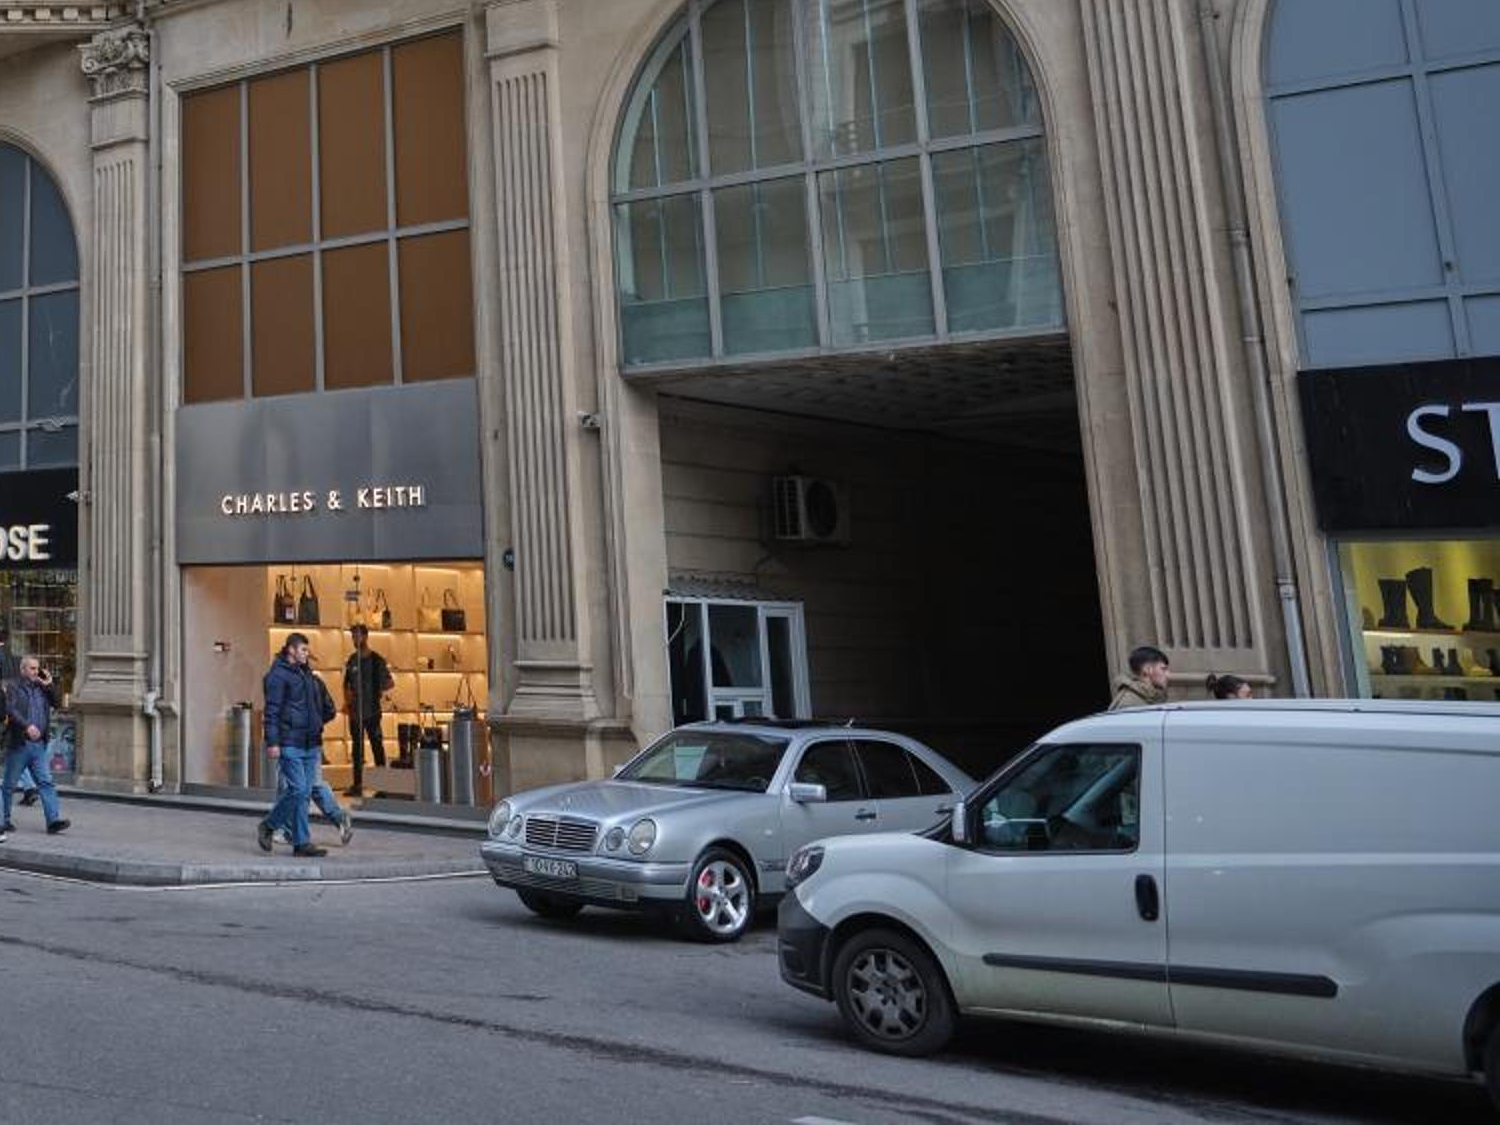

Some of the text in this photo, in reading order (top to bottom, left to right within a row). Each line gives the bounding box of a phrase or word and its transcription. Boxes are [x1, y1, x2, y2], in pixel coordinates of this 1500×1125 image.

[221, 486, 424, 514] CHARLES & KEITH
